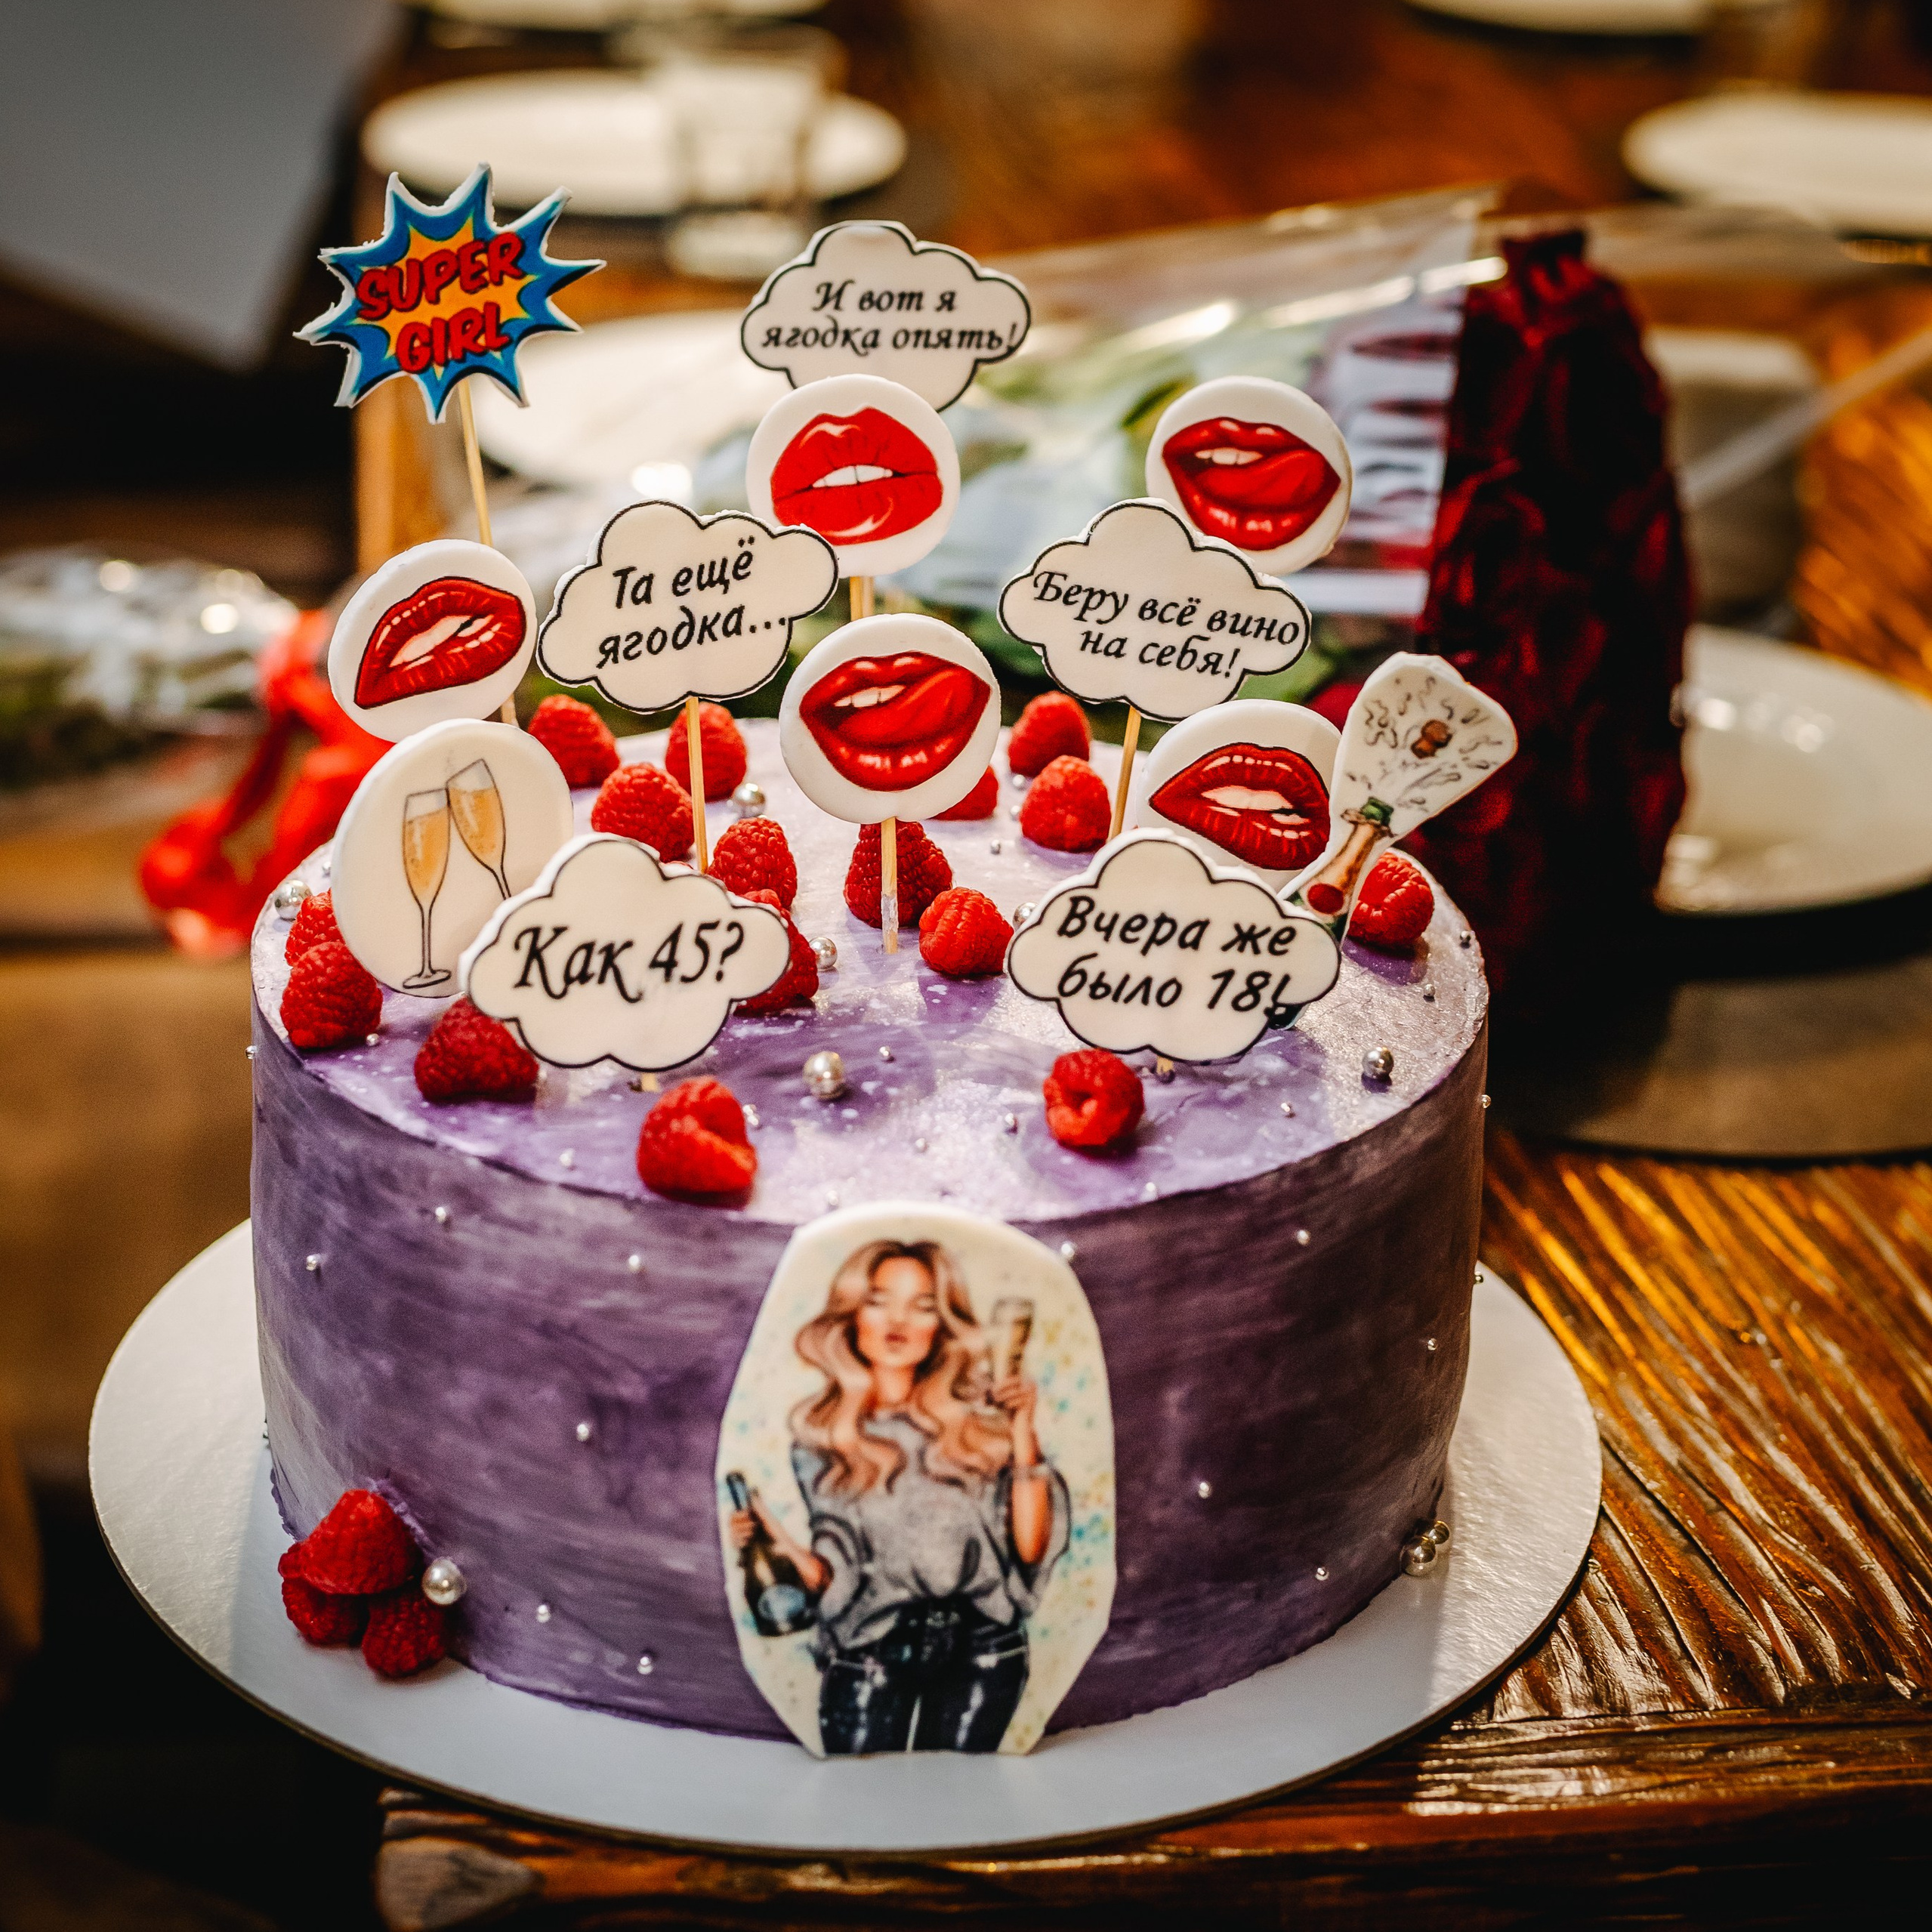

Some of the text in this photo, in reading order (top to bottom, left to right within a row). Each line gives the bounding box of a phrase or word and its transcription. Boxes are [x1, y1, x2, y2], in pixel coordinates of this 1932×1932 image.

[355, 231, 527, 319] SUPER
[813, 279, 957, 312] И вот я
[396, 302, 511, 374] GIRL
[761, 315, 1017, 356] ягодка опять!
[613, 535, 755, 609] Та ещё
[596, 604, 788, 669] ягодка...
[1033, 571, 1300, 644] Беру всё вино
[1080, 630, 1241, 677] на себя!
[1057, 895, 1297, 957] Вчера же
[513, 920, 744, 1003] Как 45?
[1057, 953, 1291, 1018] было 18!
